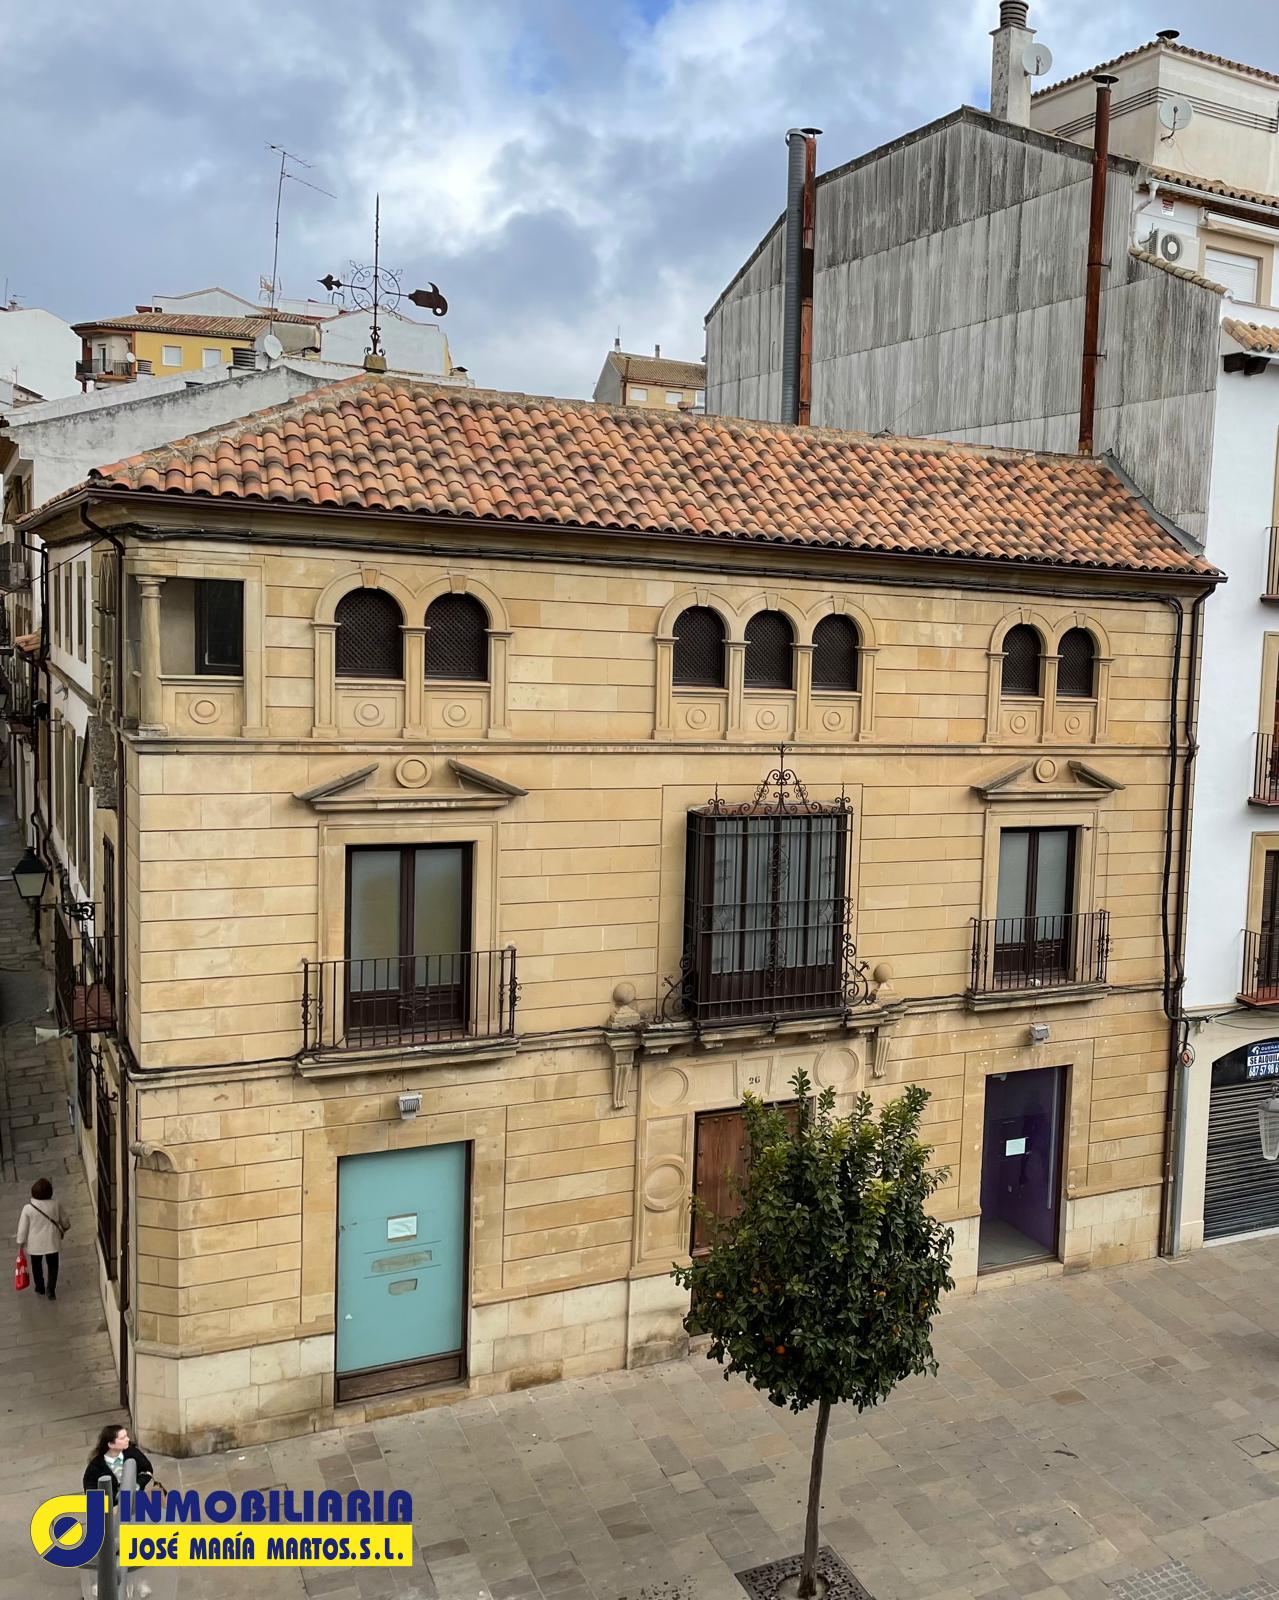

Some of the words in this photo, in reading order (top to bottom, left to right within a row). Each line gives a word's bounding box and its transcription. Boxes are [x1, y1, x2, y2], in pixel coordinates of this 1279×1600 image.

[1250, 1056, 1258, 1065] SE
[1249, 1066, 1259, 1076] 687
[1260, 1065, 1266, 1075] 57
[1268, 1064, 1274, 1074] 98
[748, 1075, 761, 1085] 26
